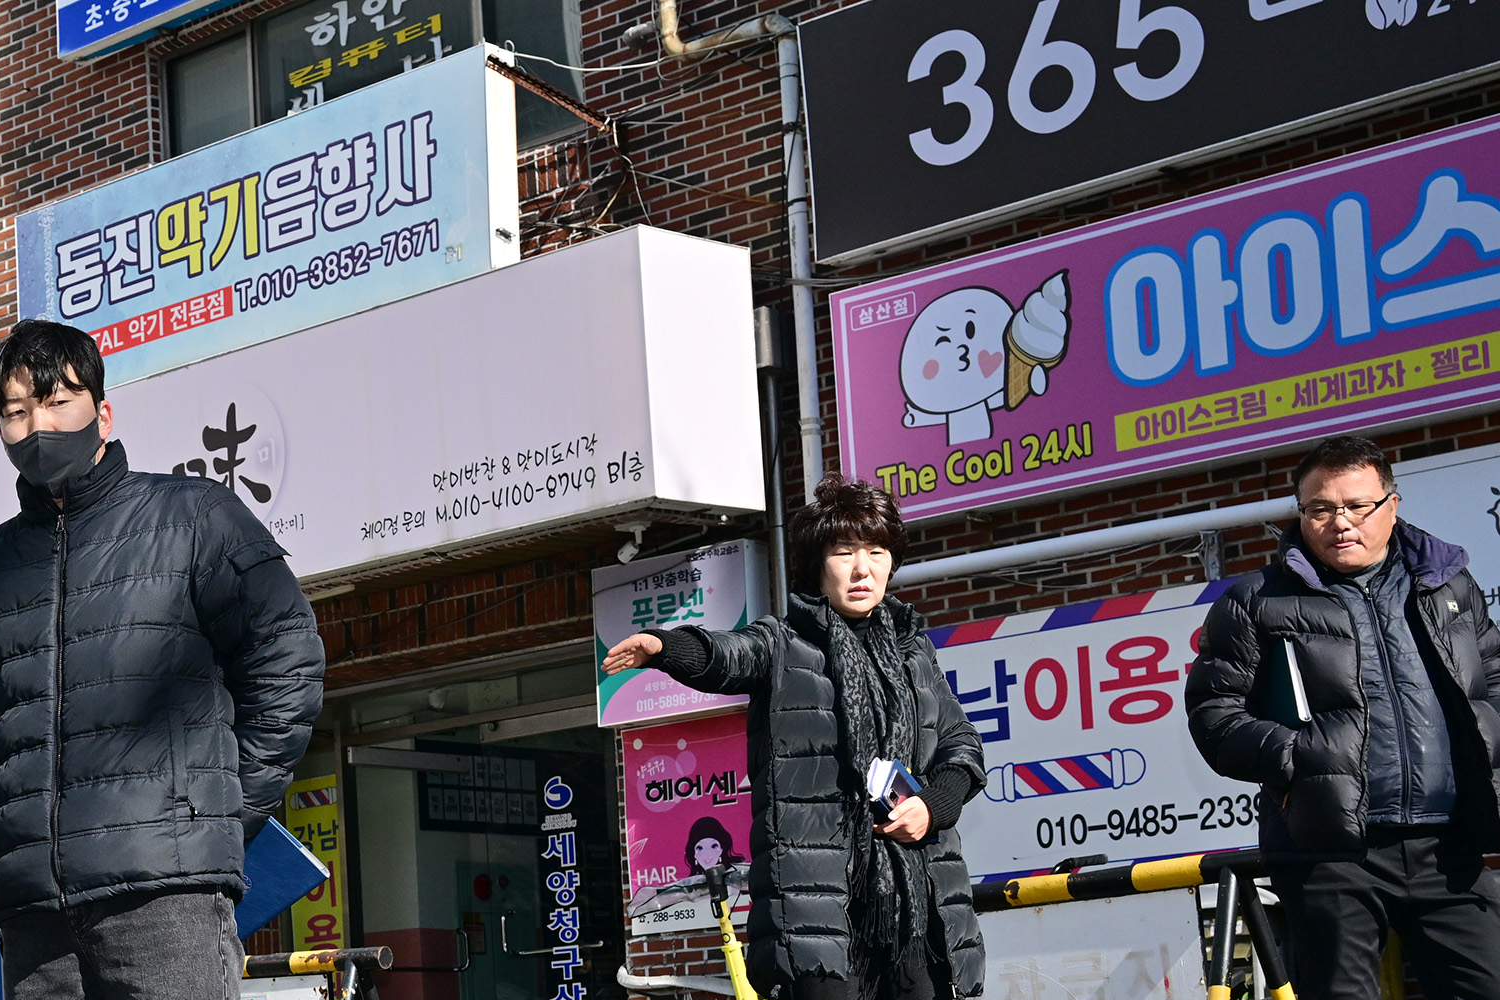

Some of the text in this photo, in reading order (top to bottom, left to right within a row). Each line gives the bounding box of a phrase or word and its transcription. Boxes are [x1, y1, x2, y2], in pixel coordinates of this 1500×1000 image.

[288, 13, 443, 89] 컴퓨터
[907, 0, 1205, 166] 365
[55, 111, 438, 319] 동진악기음향사
[233, 218, 440, 313] T.010-3852-7671
[127, 309, 165, 343] 악기
[169, 290, 226, 332] 전문점
[857, 296, 910, 327] 삼산점
[1133, 333, 1492, 442] 아이스크림 세계과자 젤리
[876, 421, 1094, 498] The Cool 24시
[359, 515, 399, 541] 체인점
[402, 510, 426, 533] 문의
[435, 466, 597, 525] M.010-4100-8749
[631, 567, 703, 592] 1:1 맞춤학습
[631, 586, 706, 629] 푸르넷
[636, 865, 678, 887] HAIR
[652, 908, 696, 923] 288-9533
